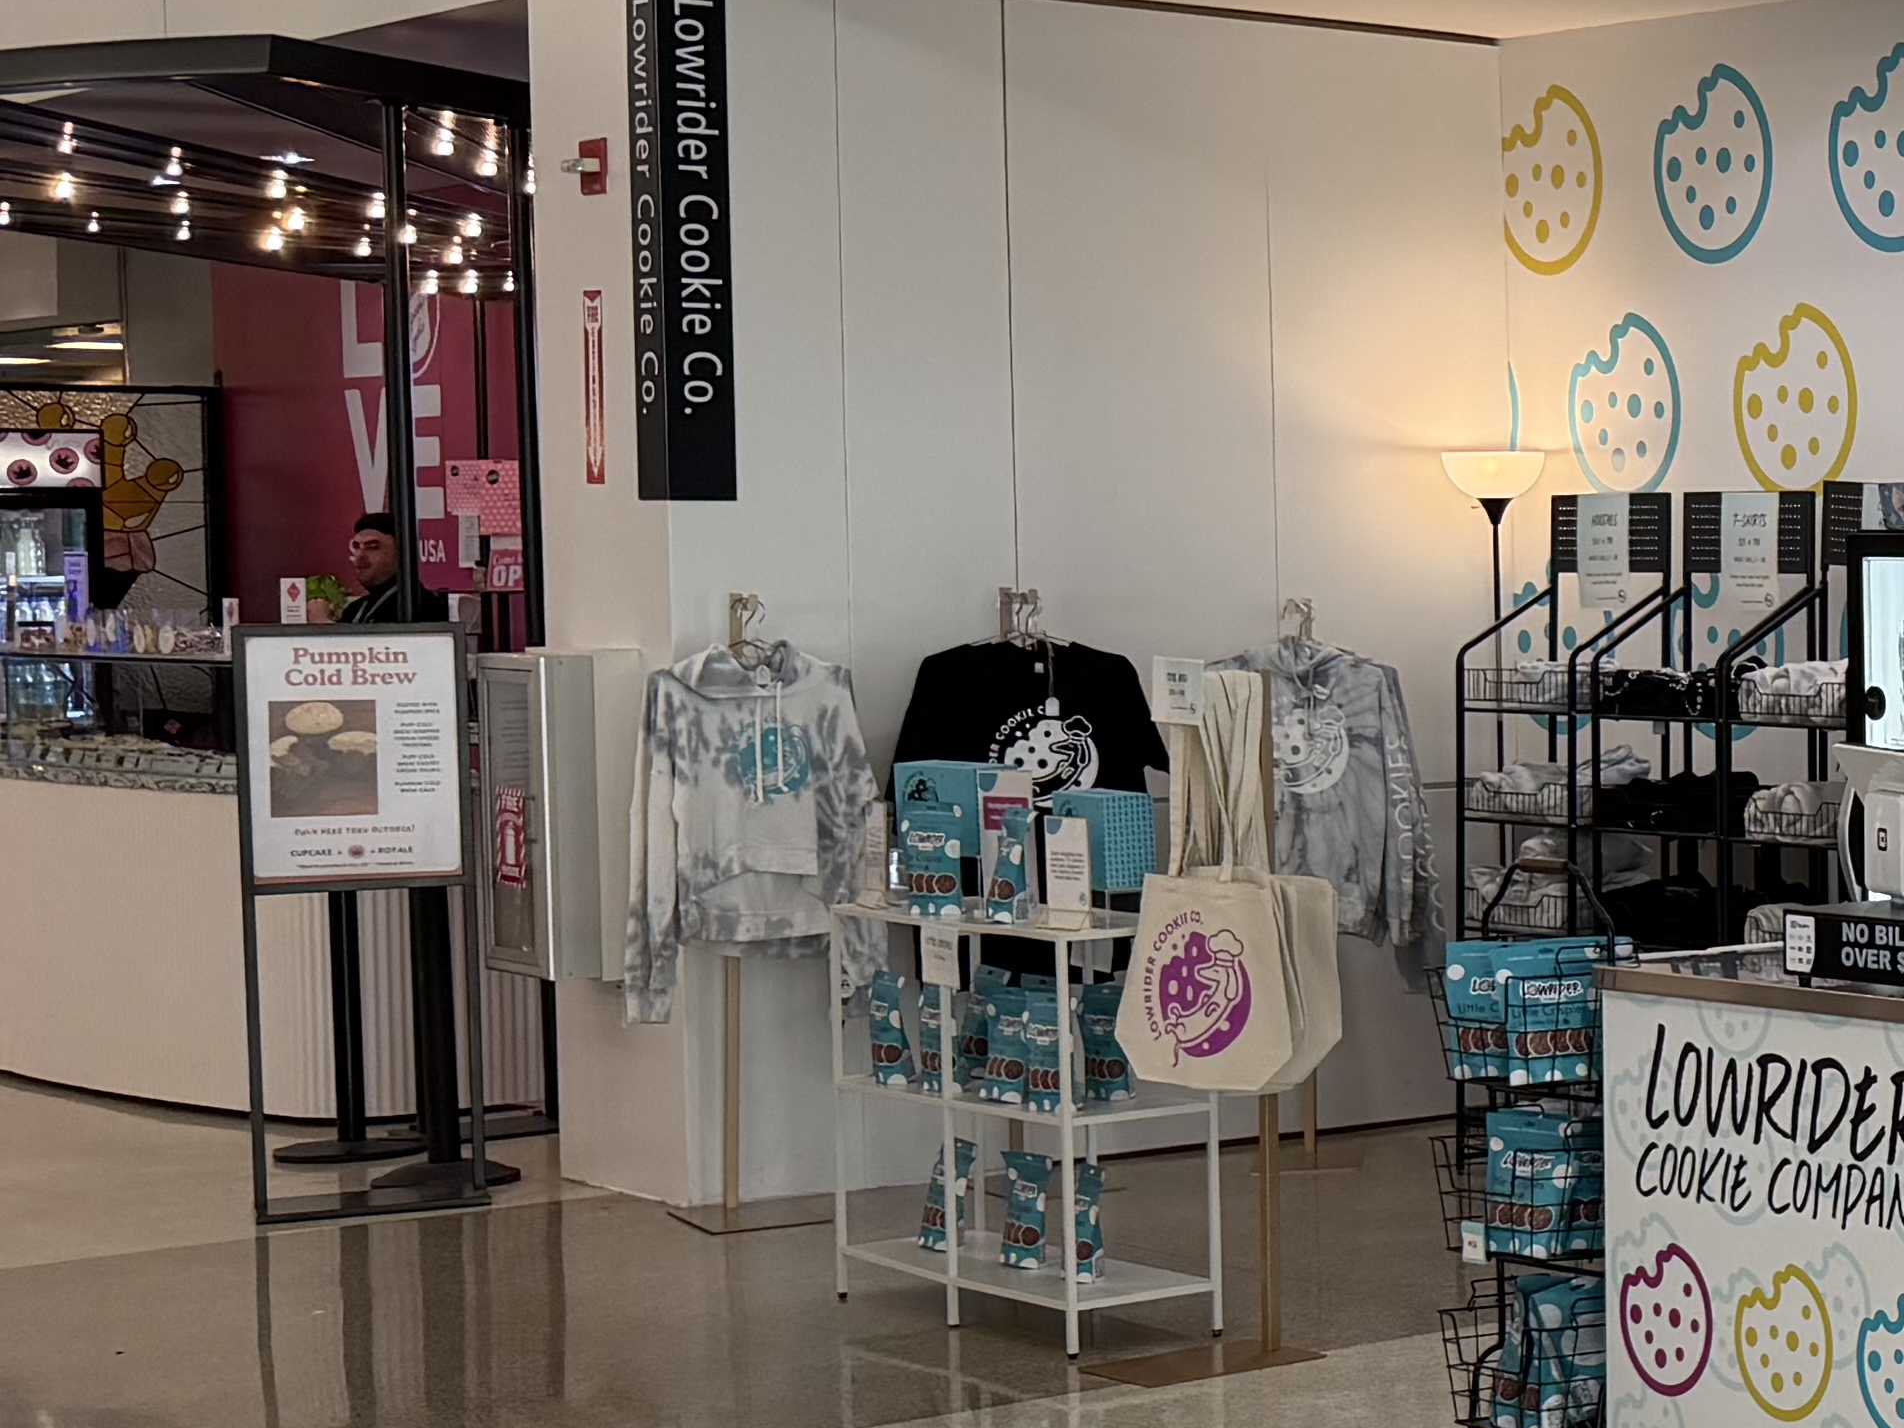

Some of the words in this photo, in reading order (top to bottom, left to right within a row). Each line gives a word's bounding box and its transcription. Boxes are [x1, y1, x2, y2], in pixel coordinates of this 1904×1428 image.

[637, 194, 657, 335] Cookie
[678, 194, 722, 335] Cookie
[641, 351, 659, 414] Co.
[683, 351, 723, 414] Co.
[420, 539, 447, 563] USA
[493, 565, 522, 586] OP
[292, 647, 408, 666] Pumpkin
[285, 669, 342, 686] Cold
[351, 669, 417, 685] Brew
[996, 708, 1034, 740] COOKIE
[290, 848, 333, 857] CUPCAKE
[378, 846, 413, 854] ROYALE
[1842, 922, 1869, 943] NO
[1841, 946, 1892, 970] OVER
[1144, 956, 1162, 1041] LOWRIDER
[1153, 912, 1187, 952] COOKIE
[1635, 1141, 1753, 1212] COOKIE
